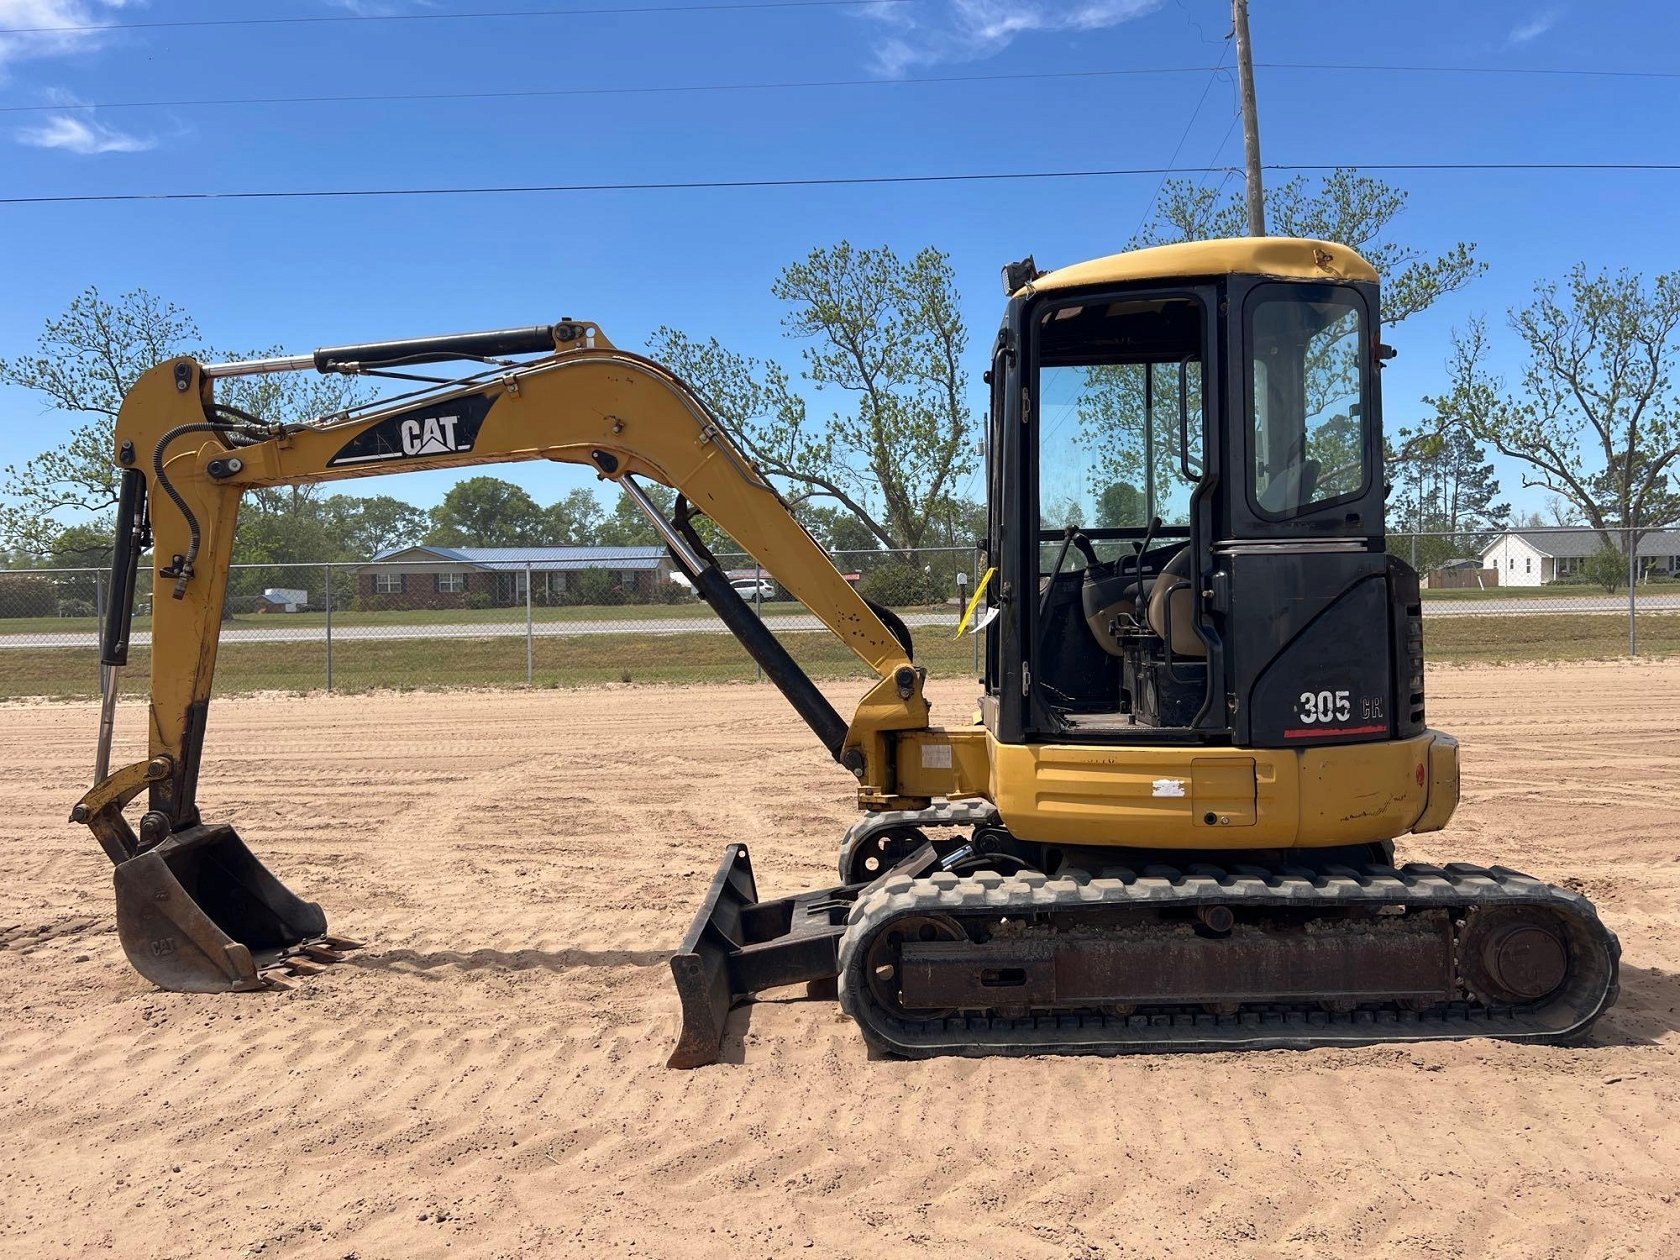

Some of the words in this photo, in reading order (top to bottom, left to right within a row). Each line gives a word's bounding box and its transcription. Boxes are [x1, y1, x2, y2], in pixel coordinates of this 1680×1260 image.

[401, 415, 458, 456] CAT
[1300, 690, 1351, 724] 305
[1361, 697, 1384, 720] CR
[150, 937, 175, 957] CAT
